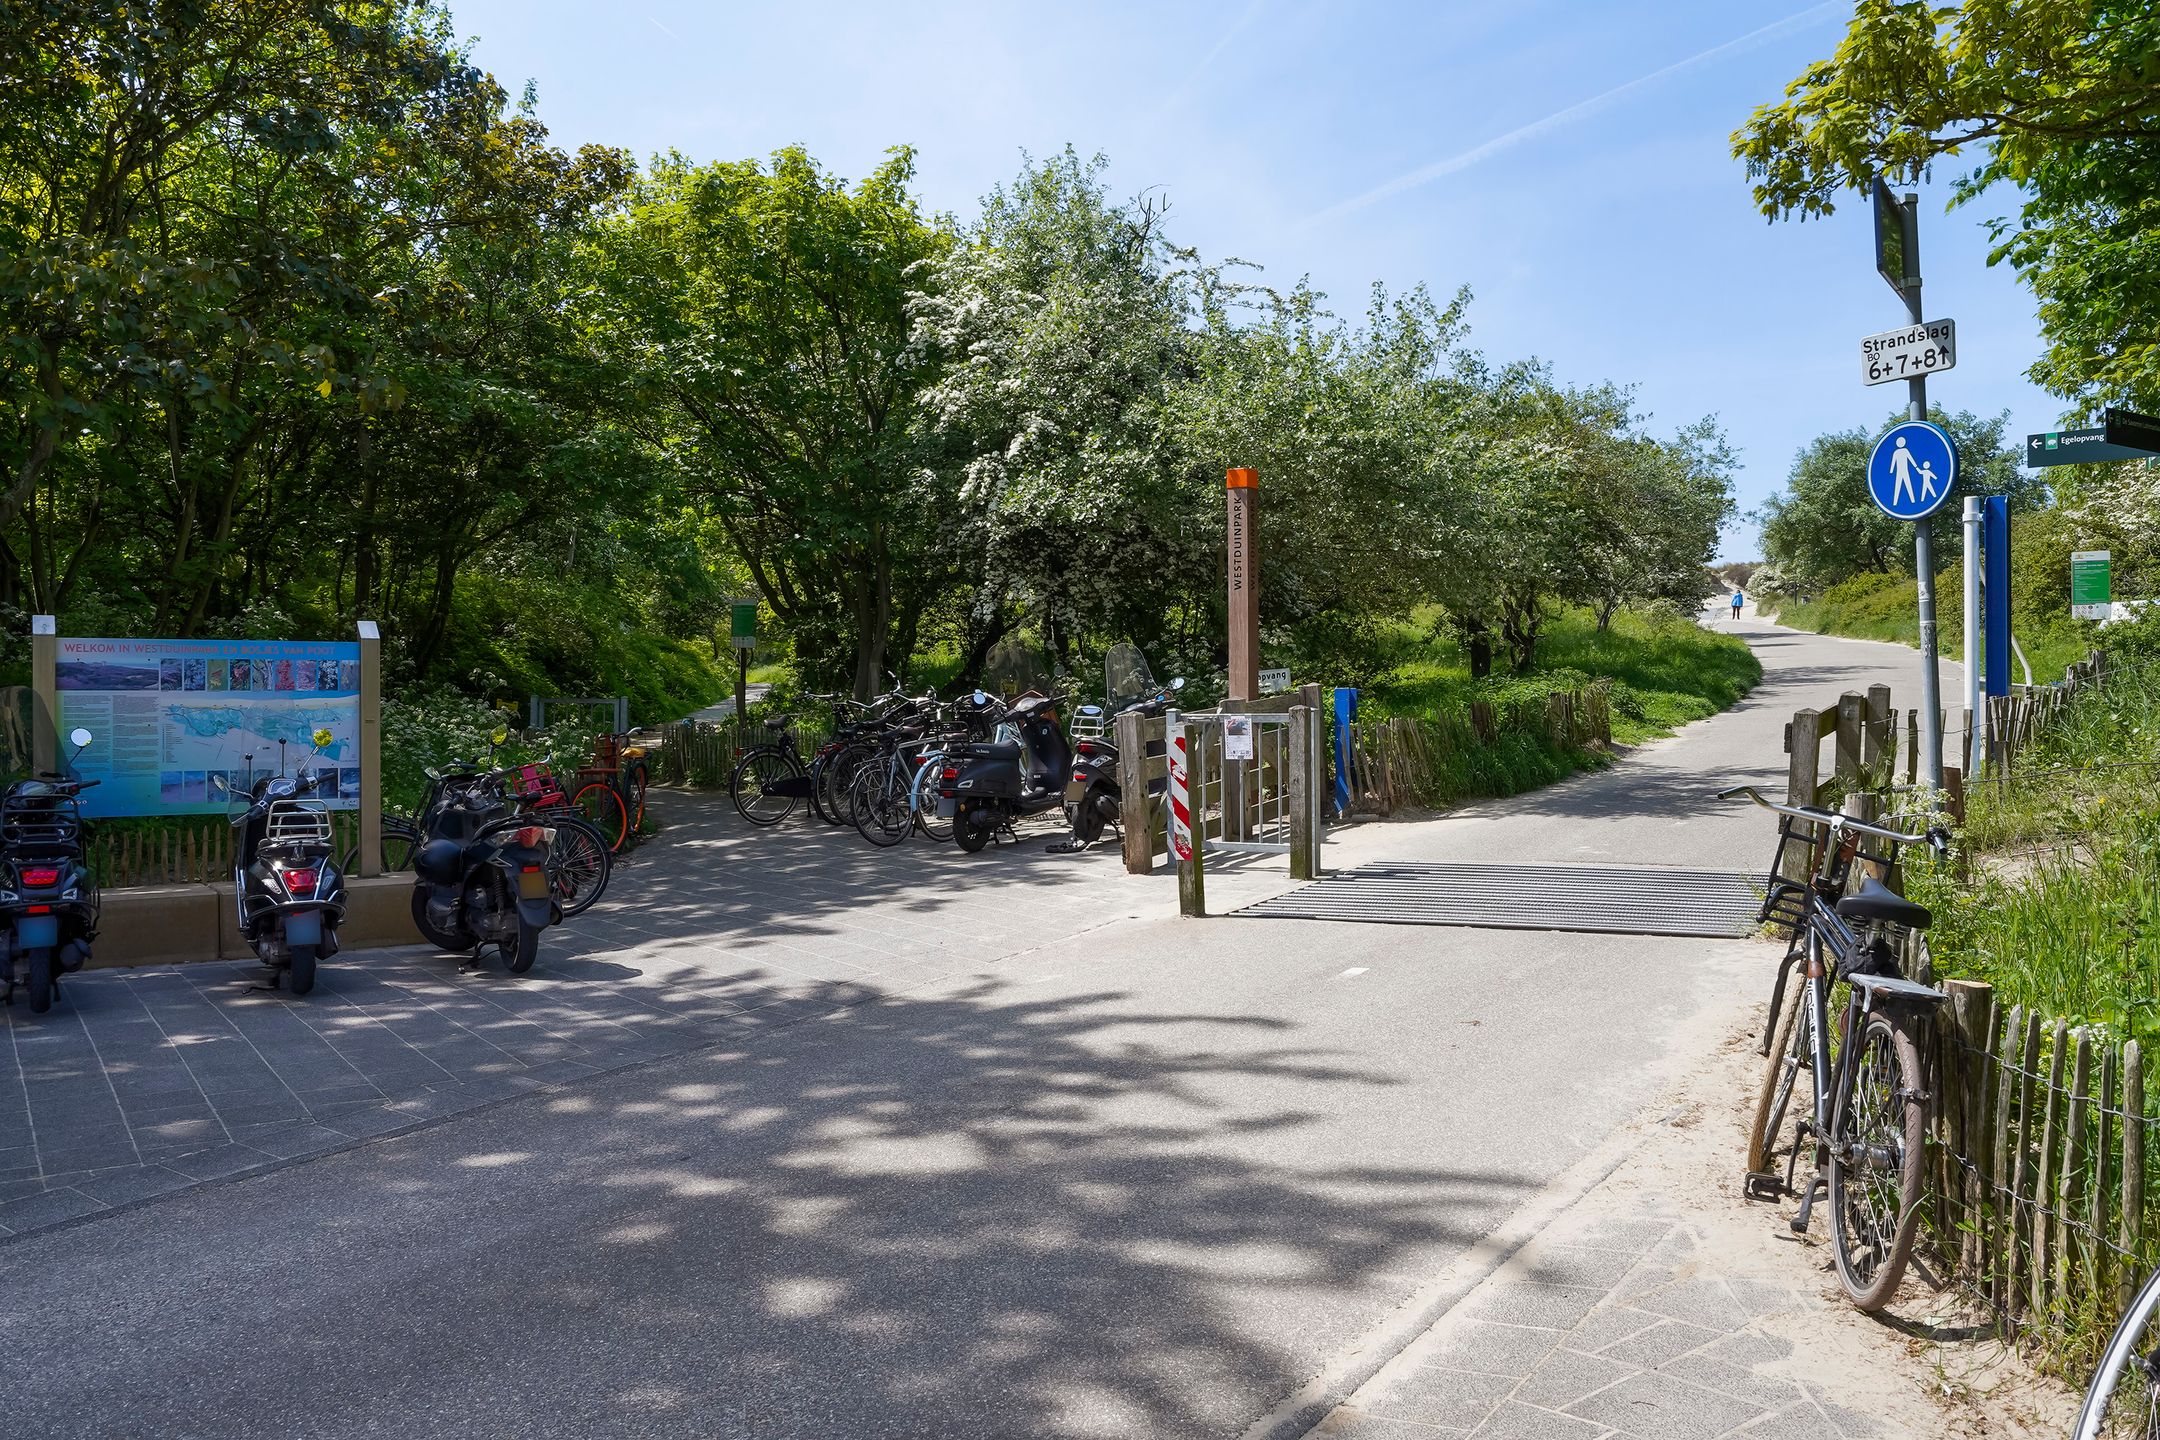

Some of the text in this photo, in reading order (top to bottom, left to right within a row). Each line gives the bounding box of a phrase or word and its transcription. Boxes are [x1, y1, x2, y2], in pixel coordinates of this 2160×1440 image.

[1863, 325, 1949, 353] Strandslag
[2061, 433, 2105, 445] Egelopvang
[1233, 497, 1242, 590] WESTDUINPARK
[64, 643, 115, 653] WELKOM
[119, 644, 130, 653] IN
[135, 644, 219, 654] WESTDUINPARK
